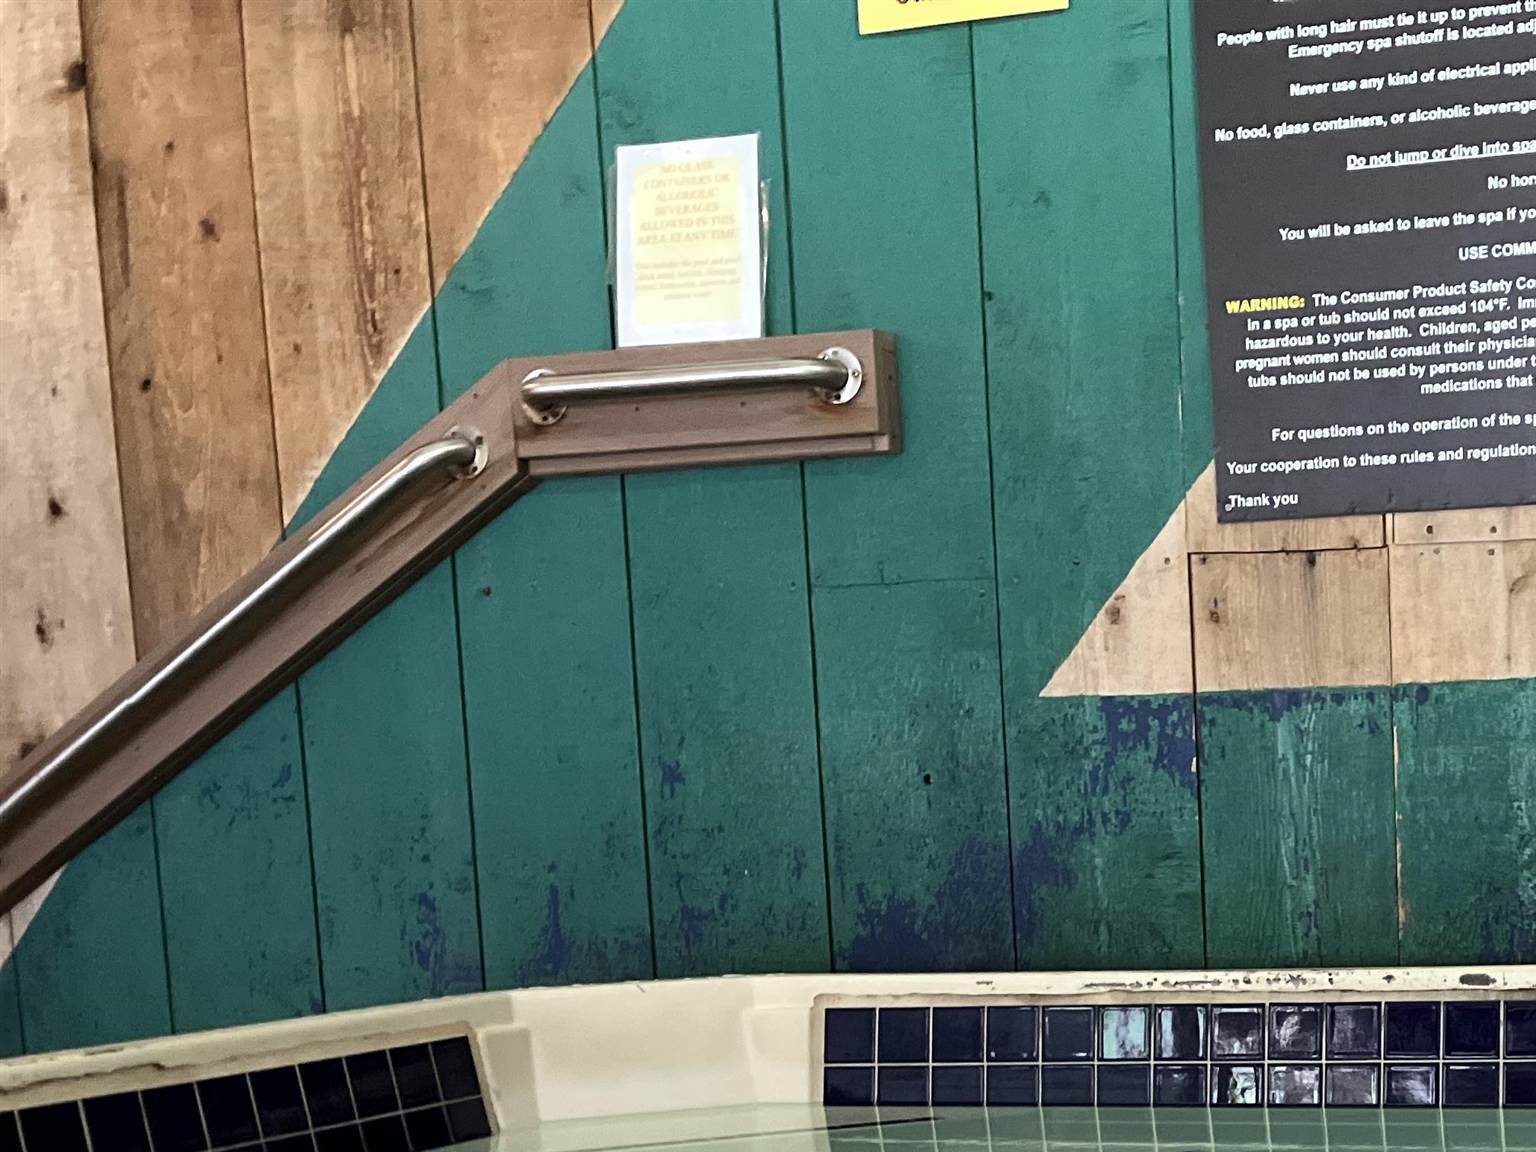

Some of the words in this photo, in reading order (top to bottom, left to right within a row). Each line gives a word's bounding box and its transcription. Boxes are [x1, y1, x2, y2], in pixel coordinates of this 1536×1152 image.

[1289, 82, 1330, 97] Never
[1331, 79, 1358, 93] use
[1359, 76, 1385, 91] any
[1387, 70, 1418, 87] kind
[1420, 68, 1436, 83] of
[1437, 61, 1501, 82] electrical
[1214, 128, 1235, 142] No
[1236, 123, 1272, 140] food,
[1273, 121, 1311, 140] glass
[1312, 115, 1388, 133] containers,
[1390, 112, 1407, 125] or
[1407, 104, 1471, 123] alcoholic
[1487, 175, 1509, 190] No
[1278, 227, 1305, 241] You
[1307, 223, 1331, 239] will
[1333, 222, 1351, 237] be
[1353, 217, 1394, 235] asked
[1396, 217, 1412, 231] to
[1413, 215, 1450, 230] leave
[1452, 212, 1476, 226] the
[1477, 210, 1504, 227] spa
[1506, 206, 1517, 221] if
[1458, 244, 1489, 261] USE
[1225, 295, 1306, 314] WARNING:
[1311, 292, 1338, 308] The
[1340, 288, 1411, 305] Consumer
[1412, 281, 1467, 299] Product
[1469, 278, 1513, 295] Safety
[1247, 317, 1260, 332] in
[1262, 319, 1272, 330] a
[1274, 317, 1299, 332] spa
[1300, 315, 1317, 328] or
[1318, 311, 1341, 326] tub
[1343, 307, 1390, 324] should
[1392, 305, 1416, 320] not
[1418, 300, 1467, 318] exceed
[1469, 297, 1511, 314] 104°F.
[1235, 353, 1292, 373] pregnant
[1292, 352, 1339, 366] women
[1341, 345, 1388, 363] should
[1390, 341, 1442, 359] consult
[1443, 339, 1476, 355] their
[1247, 374, 1277, 388] tubs
[1279, 369, 1325, 386] should
[1328, 368, 1351, 383] not
[1353, 366, 1371, 381] be
[1373, 363, 1407, 379] used
[1409, 362, 1427, 379] by
[1429, 360, 1485, 378] persons
[1487, 355, 1529, 371] under
[1420, 377, 1504, 395] medications
[1505, 373, 1534, 389] that
[1226, 461, 1258, 475] Your
[1260, 455, 1340, 474] cooperation
[1342, 455, 1357, 468] to
[1359, 452, 1397, 467] these
[1400, 449, 1435, 464] rules
[1437, 446, 1464, 462] and
[1229, 492, 1270, 507] Thank
[1272, 493, 1299, 509] you
